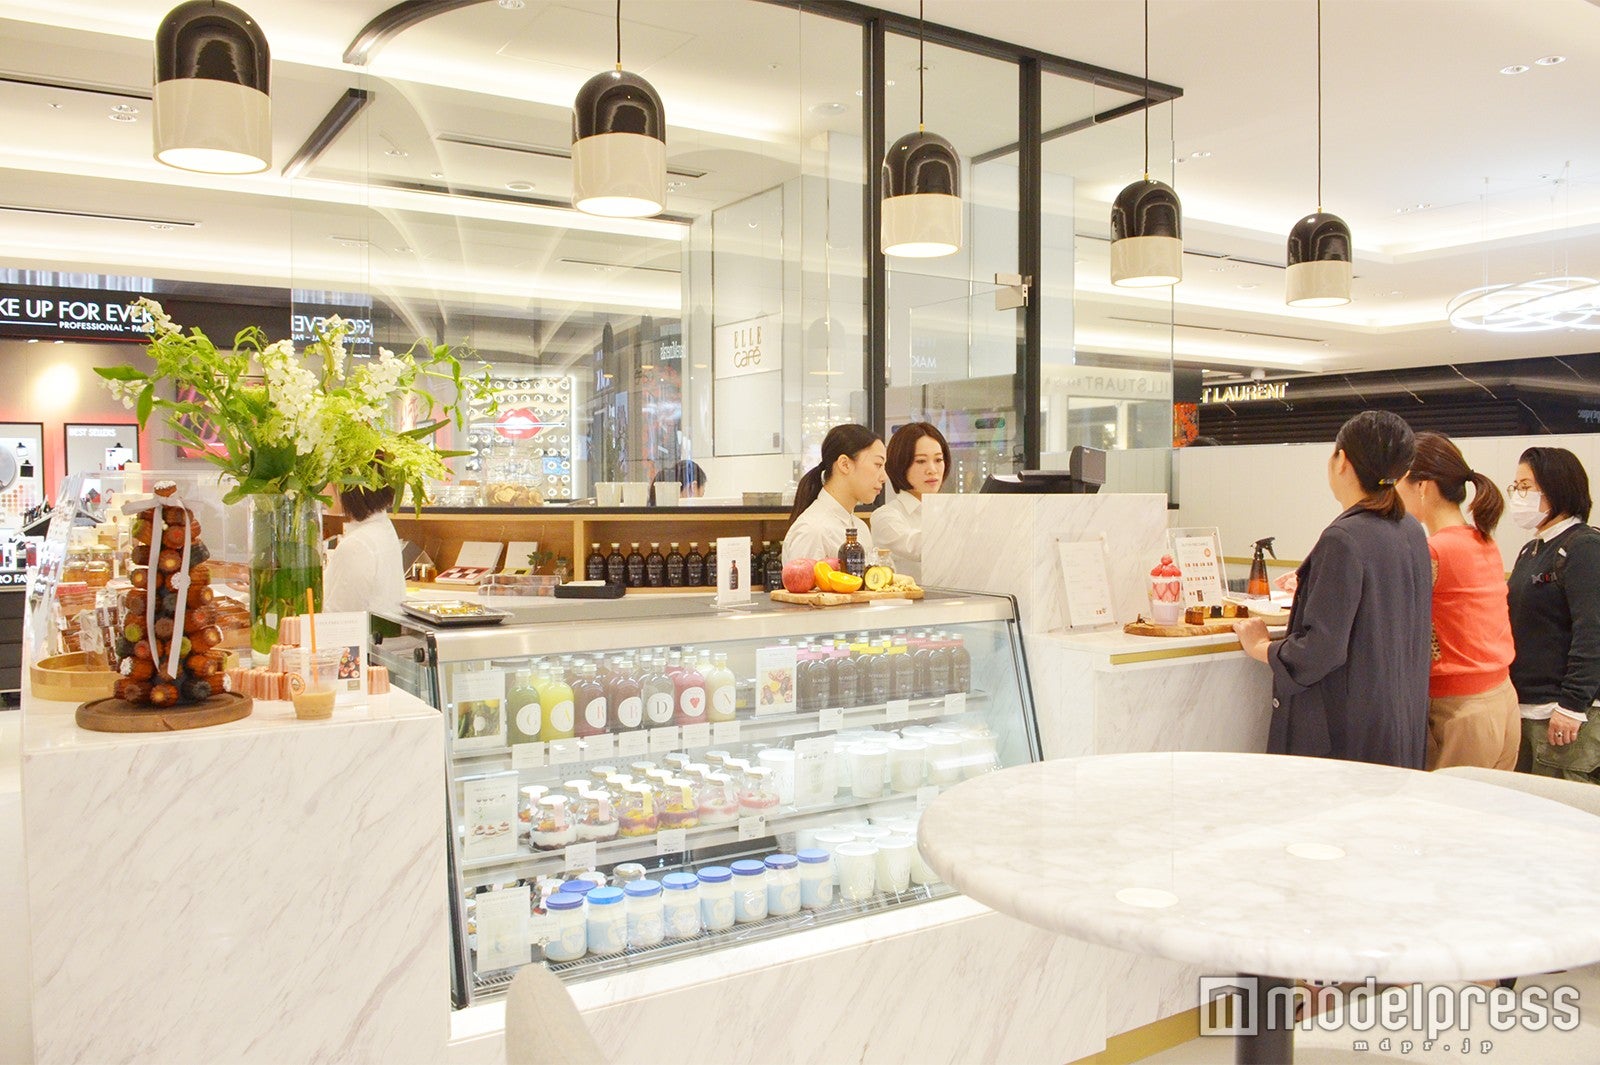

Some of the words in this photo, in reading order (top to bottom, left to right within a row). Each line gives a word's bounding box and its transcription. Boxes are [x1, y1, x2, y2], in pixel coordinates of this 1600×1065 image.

[26, 299, 54, 318] UP
[59, 301, 101, 321] FOR
[59, 321, 124, 332] PROFESSIONAL
[734, 326, 762, 349] ELLE
[1213, 382, 1290, 403] LAURENT
[655, 702, 668, 715] D
